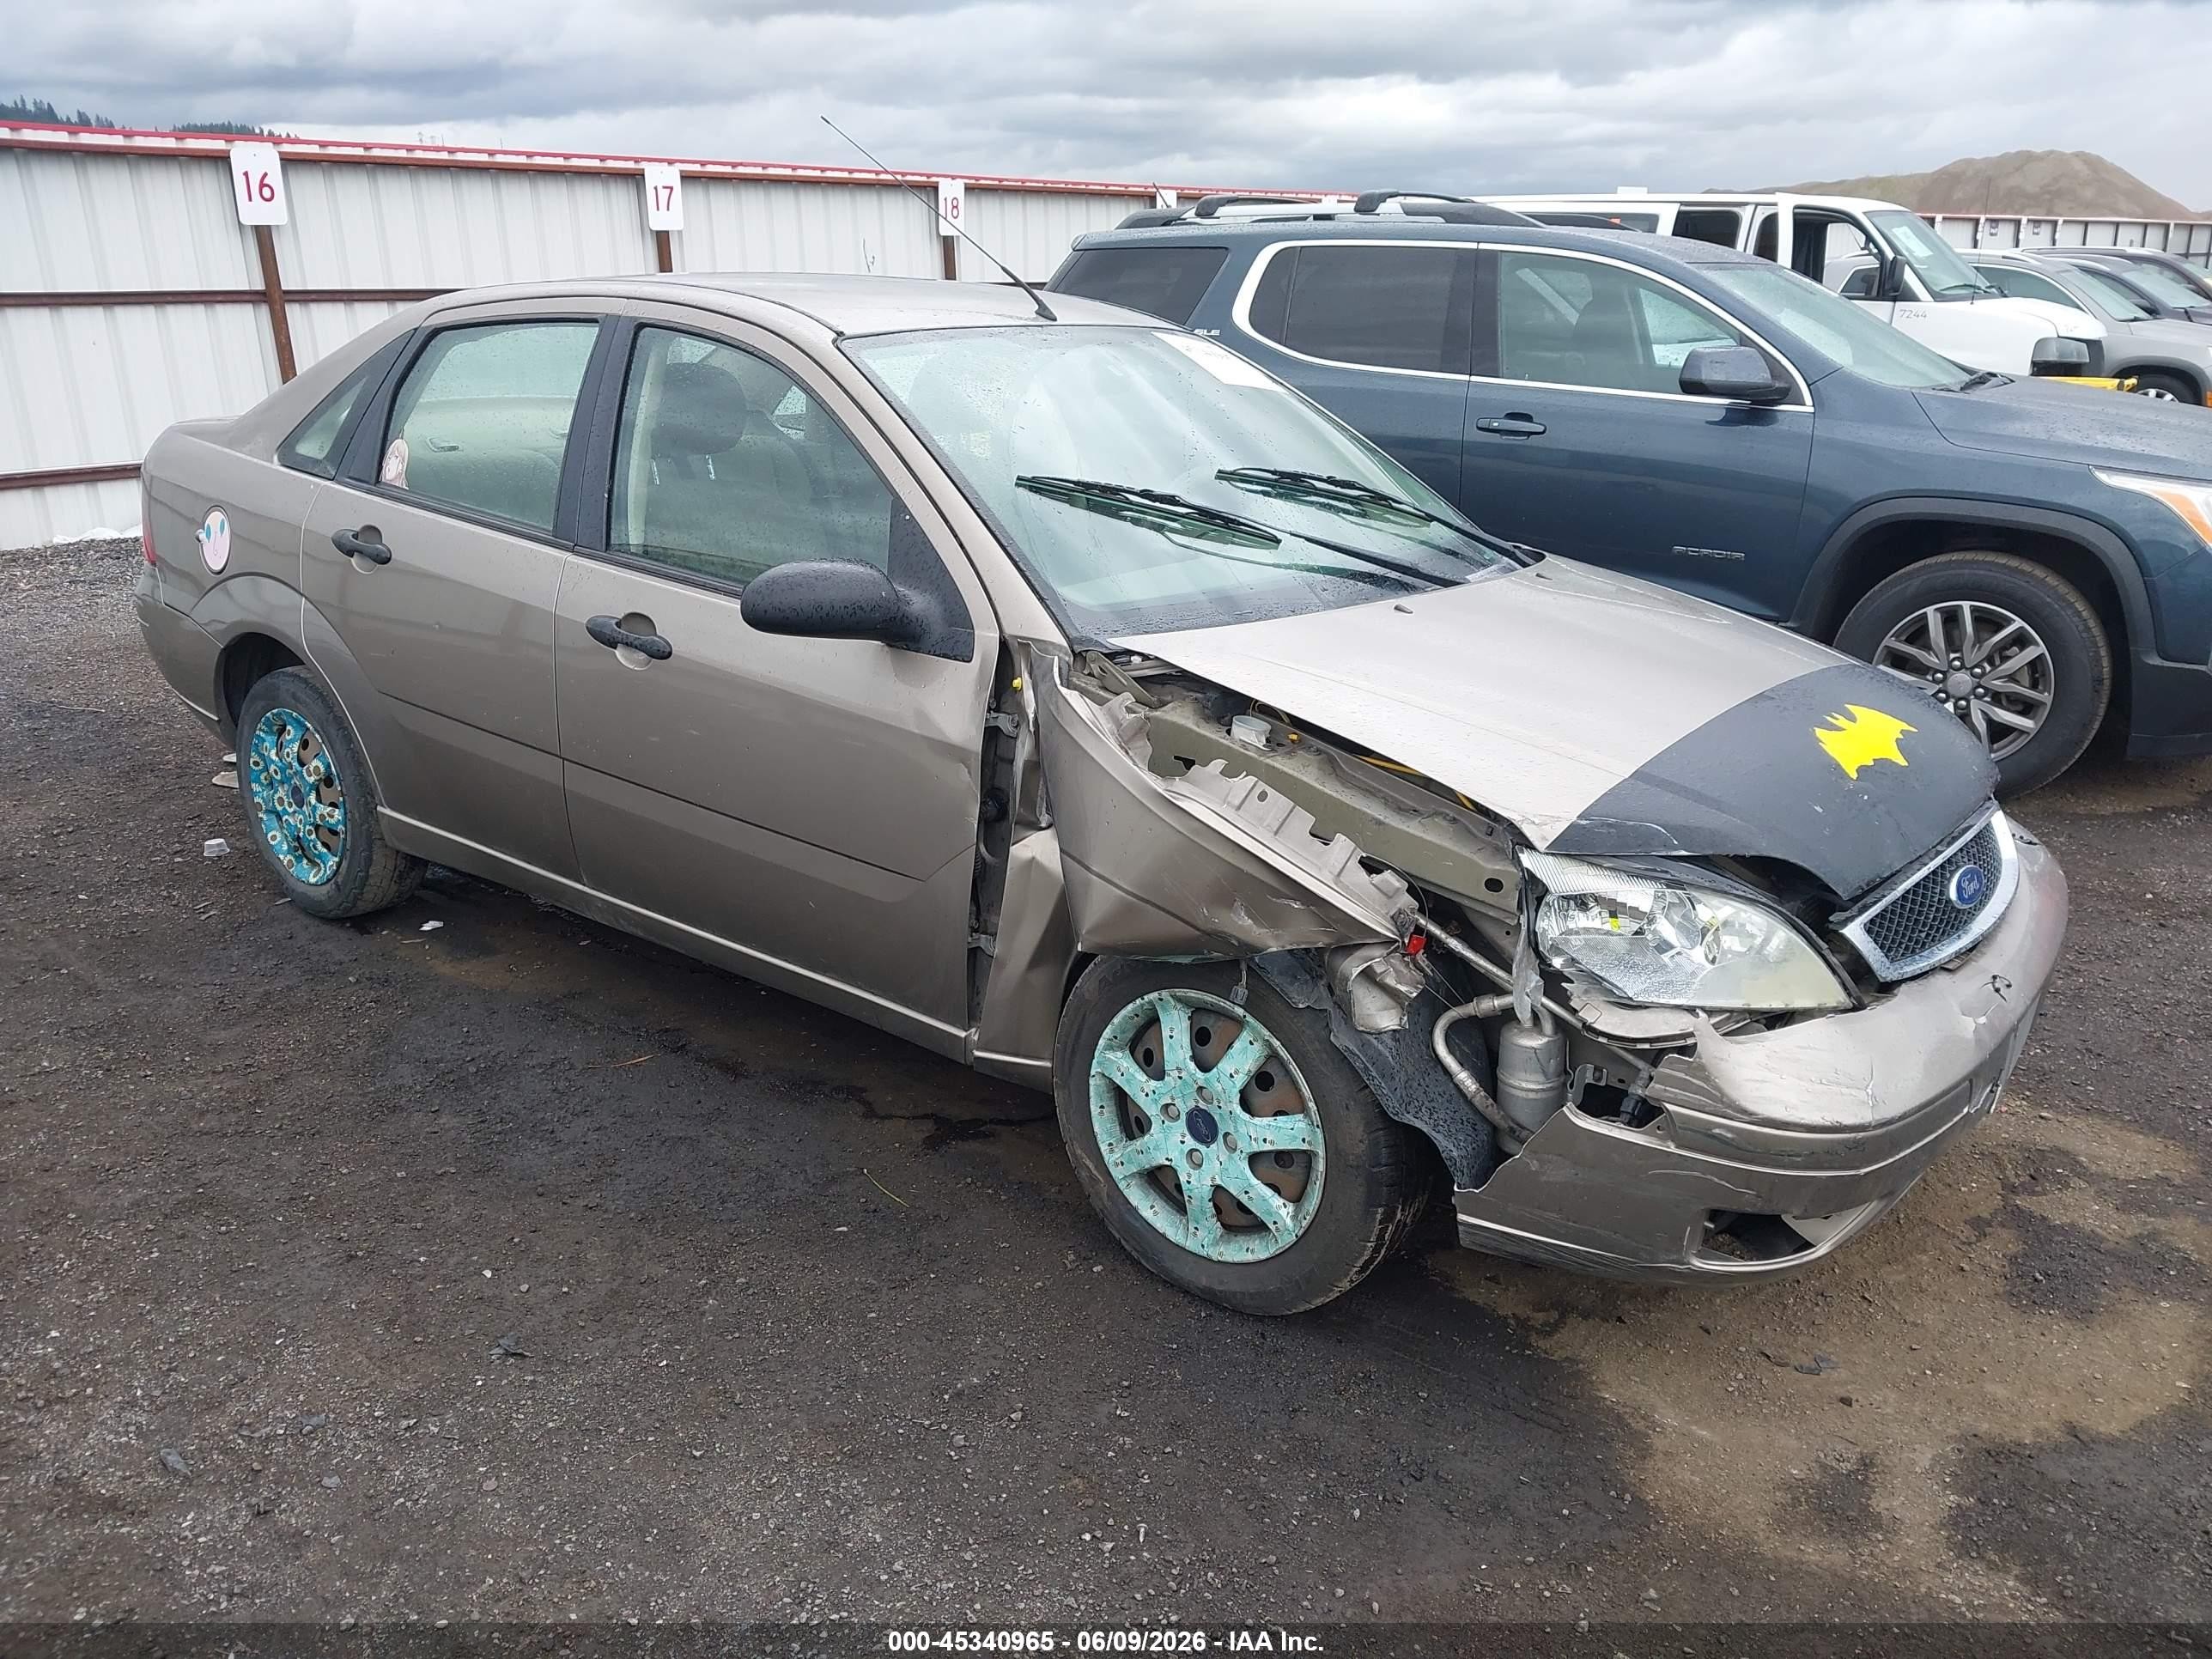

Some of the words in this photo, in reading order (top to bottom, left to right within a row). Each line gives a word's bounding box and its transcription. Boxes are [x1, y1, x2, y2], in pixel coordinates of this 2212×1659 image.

[242, 170, 275, 202] 16
[653, 185, 674, 211] 17
[944, 196, 960, 220] 18
[1899, 308, 1927, 319] 7244
